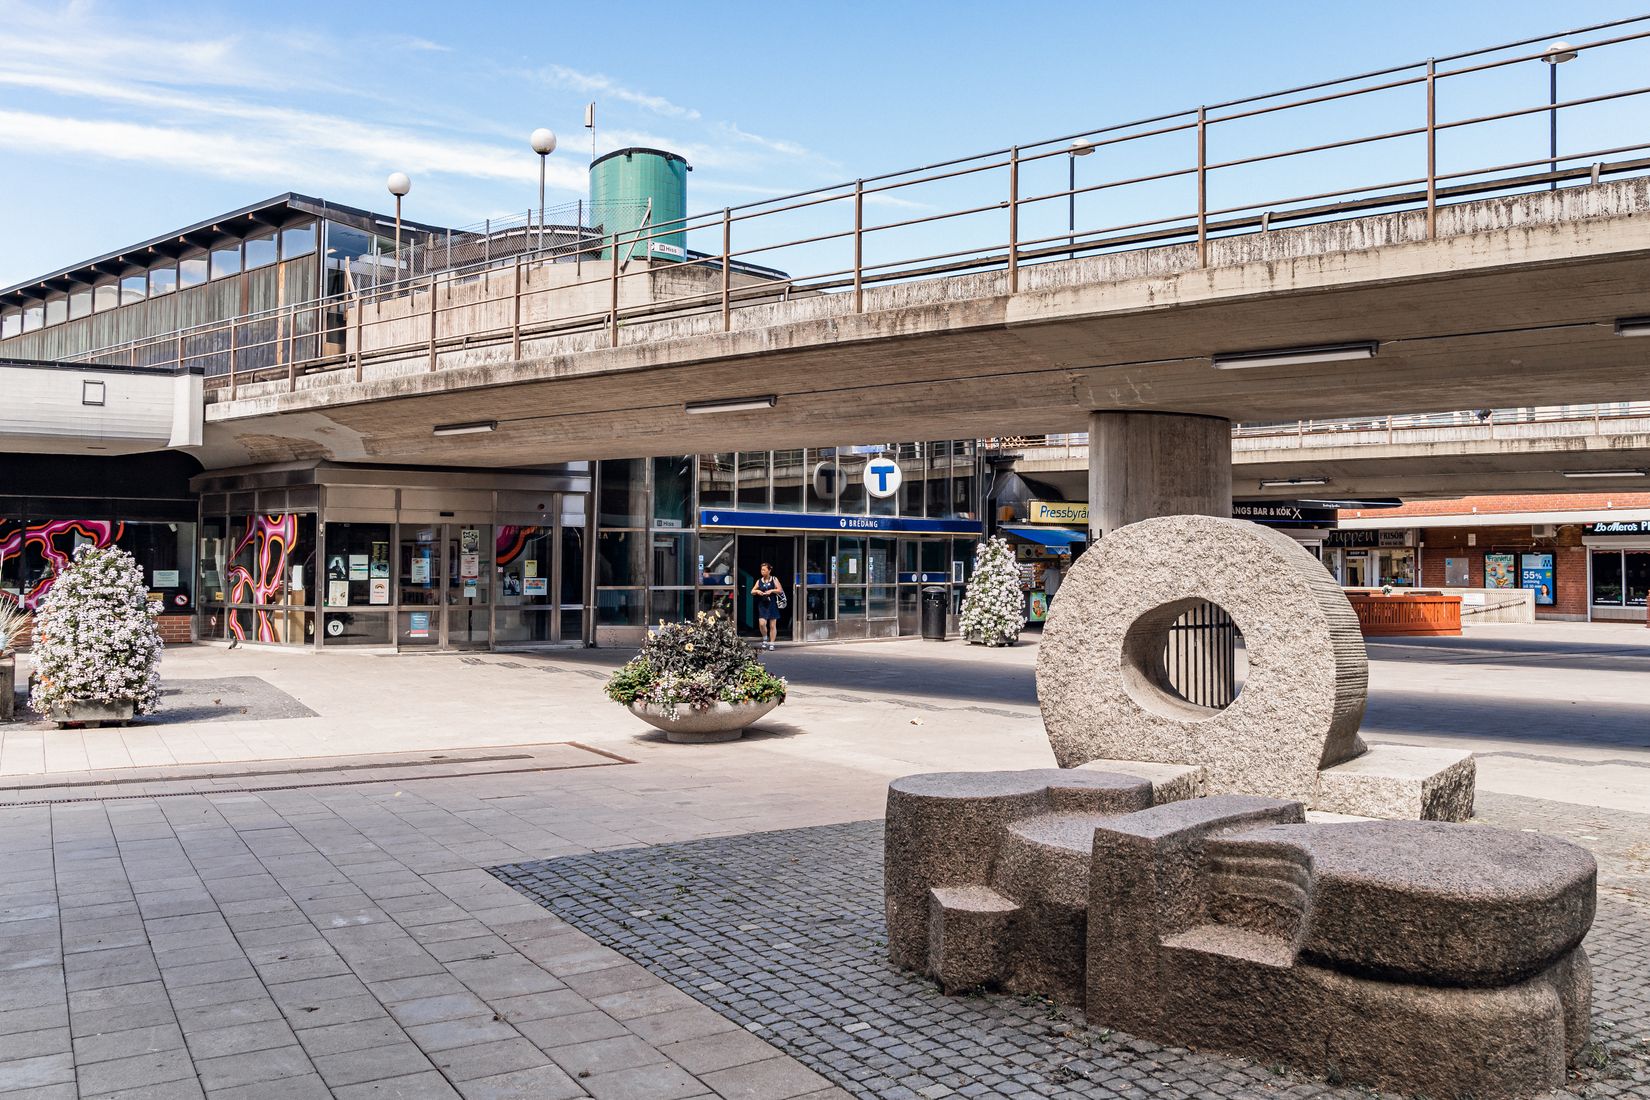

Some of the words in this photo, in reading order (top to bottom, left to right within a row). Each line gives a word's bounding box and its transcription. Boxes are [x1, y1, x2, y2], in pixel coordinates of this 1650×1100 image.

[871, 466, 894, 490] T
[1253, 507, 1267, 515] BAR
[1276, 506, 1291, 516] KÖK
[849, 518, 878, 528] BREDÄNG
[1523, 571, 1542, 580] 55%
